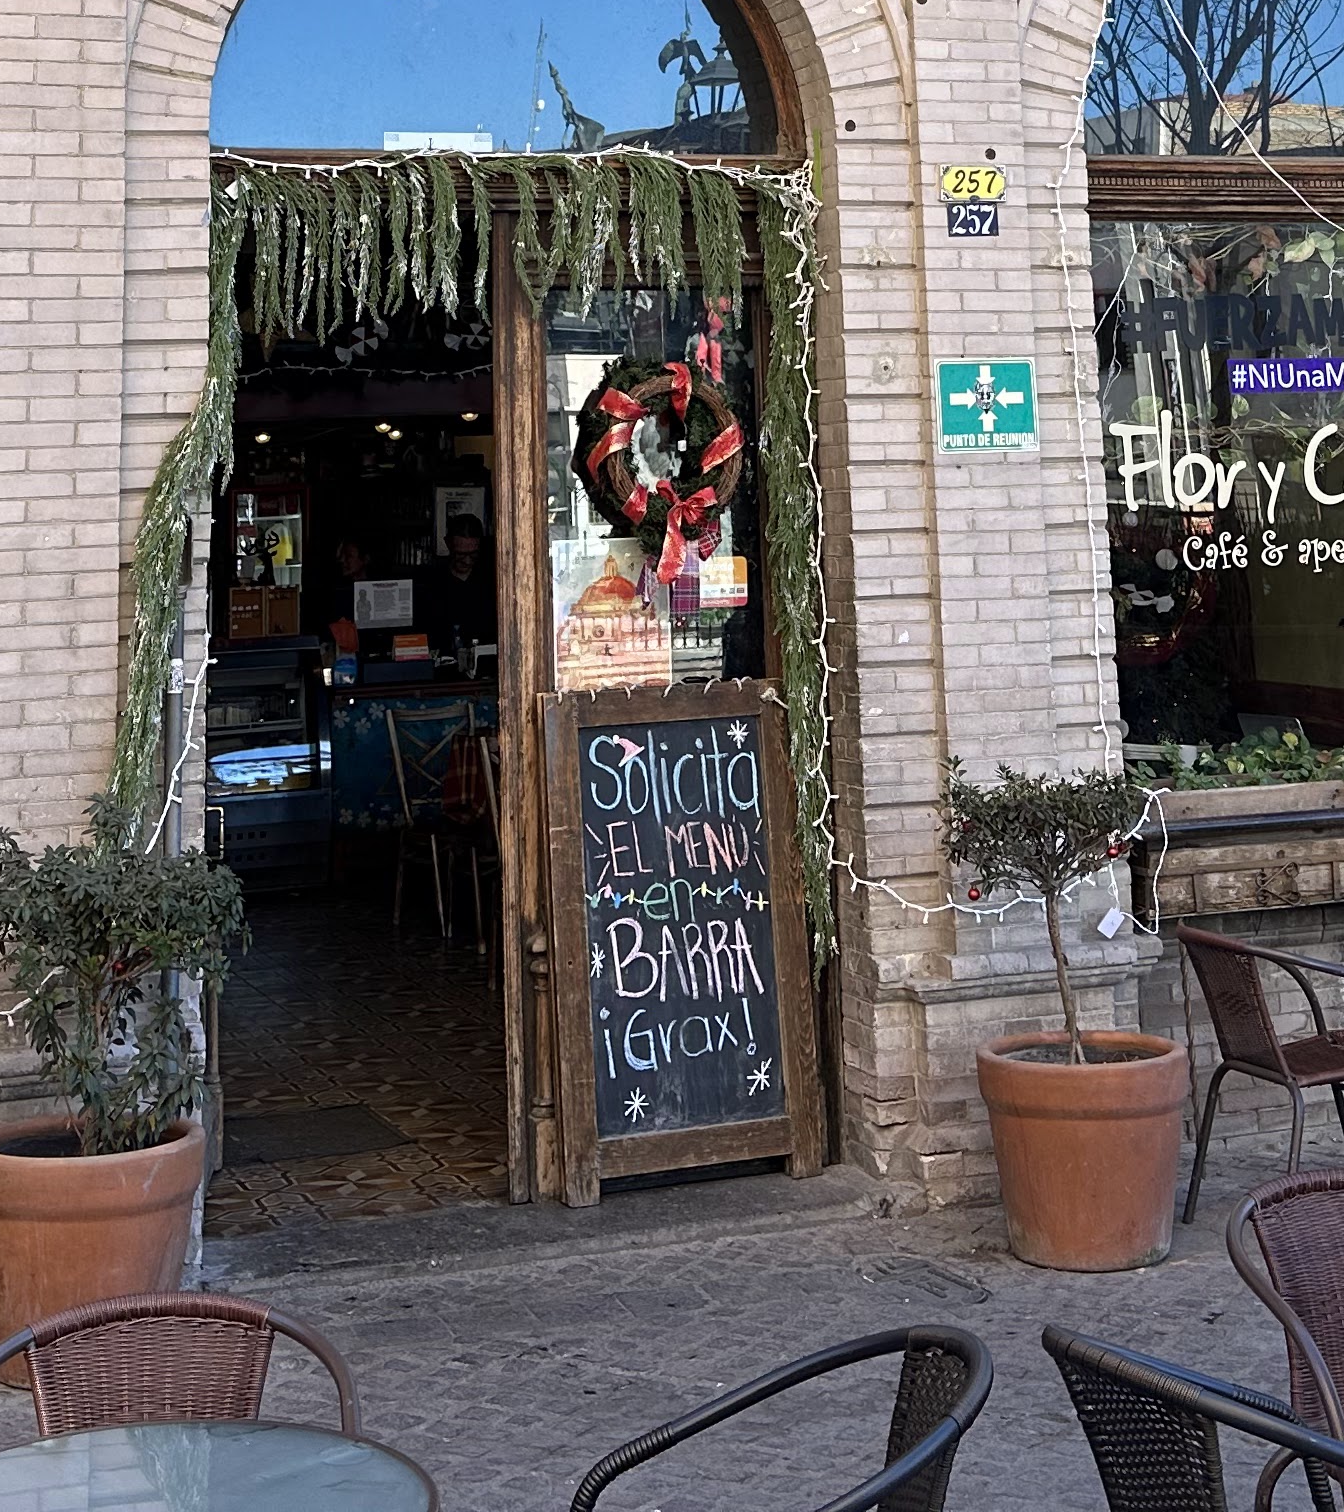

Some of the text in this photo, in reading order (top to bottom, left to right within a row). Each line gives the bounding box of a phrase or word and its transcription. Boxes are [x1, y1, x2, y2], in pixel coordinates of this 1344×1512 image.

[952, 170, 997, 194] 257
[951, 204, 995, 235] 257
[943, 433, 976, 447] PUNTO
[977, 433, 991, 447] DE
[1109, 410, 1246, 512] Flor
[1260, 462, 1287, 522] y
[1182, 530, 1249, 572] Café
[1261, 530, 1289, 567] &
[588, 725, 761, 825] Solicita
[606, 820, 654, 877] EL
[643, 878, 695, 921] en
[606, 917, 764, 1004] BARRA
